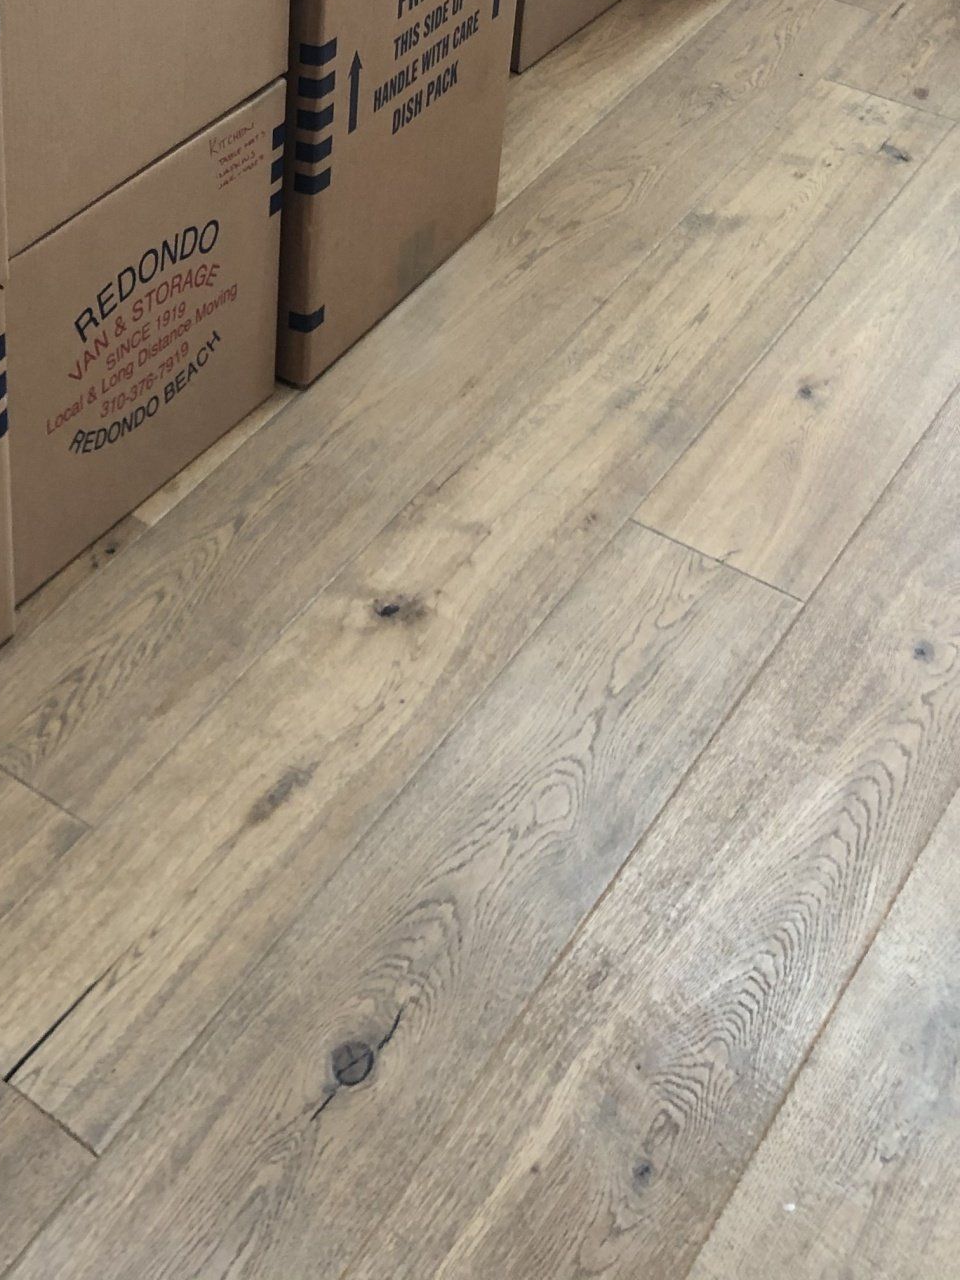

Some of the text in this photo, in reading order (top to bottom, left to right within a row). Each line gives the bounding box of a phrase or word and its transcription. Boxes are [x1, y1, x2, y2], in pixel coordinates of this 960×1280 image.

[373, 9, 480, 113] HANDLE WITH CARE
[393, 22, 420, 61] THIS
[423, 0, 449, 38] SIDE
[209, 122, 254, 160] KITCHEN
[392, 59, 459, 135] DISH PACK
[67, 264, 220, 380] VAN & STORAGE
[74, 219, 219, 343] REDONDO
[46, 283, 237, 435] Local & Long Distance Moving
[100, 342, 188, 418] 310-376-7919
[106, 302, 185, 371] SINCE 1919
[68, 330, 221, 454] REDONDO BEACH
